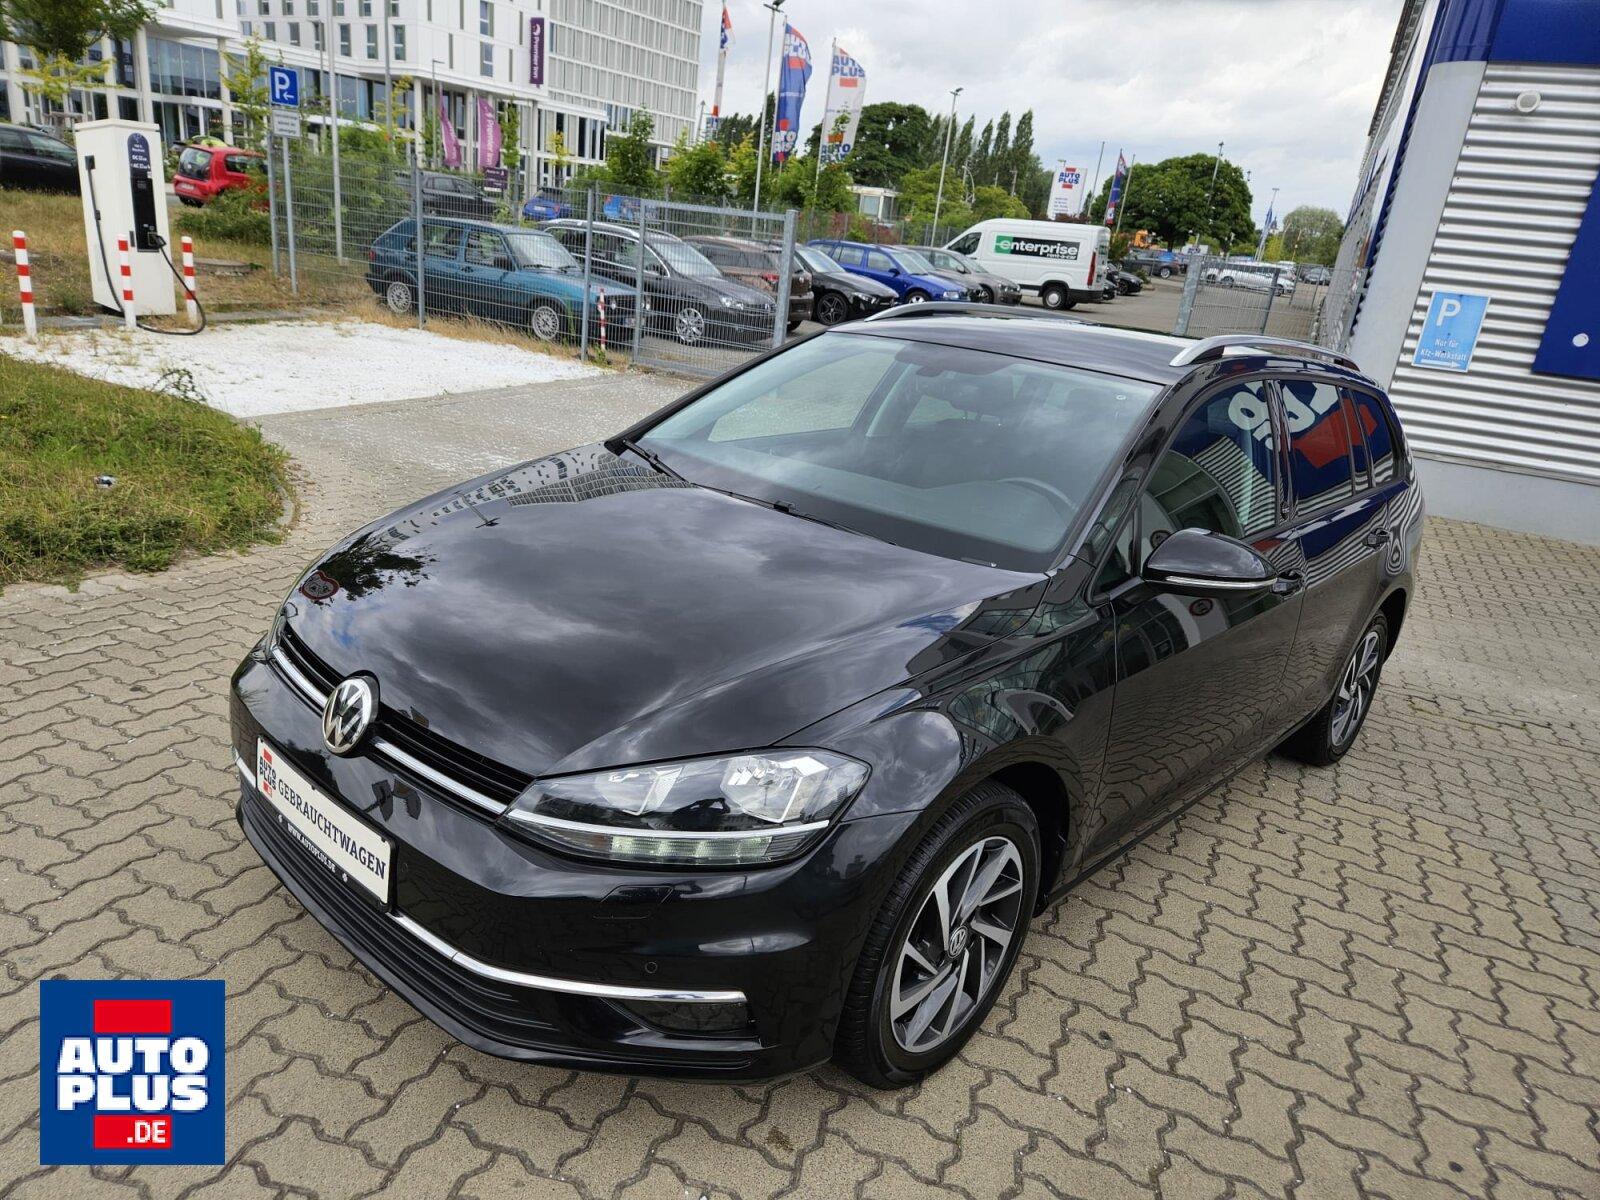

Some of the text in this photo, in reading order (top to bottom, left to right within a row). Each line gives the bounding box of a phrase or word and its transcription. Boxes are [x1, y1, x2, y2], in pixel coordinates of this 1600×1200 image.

[532, 36, 540, 66] Premier
[832, 66, 865, 77] PLUS
[274, 71, 289, 99] P
[486, 119, 495, 152] Premier
[1058, 177, 1079, 185] PLUS
[1001, 239, 1078, 255] enterprise
[1436, 298, 1461, 327] P
[1420, 348, 1468, 361] Kfz-Werkstatt
[1434, 338, 1460, 348] Nur für
[259, 755, 277, 781] AUTO
[259, 768, 277, 791] PLUS
[278, 778, 387, 881] GEBRAUCHTWAGEN
